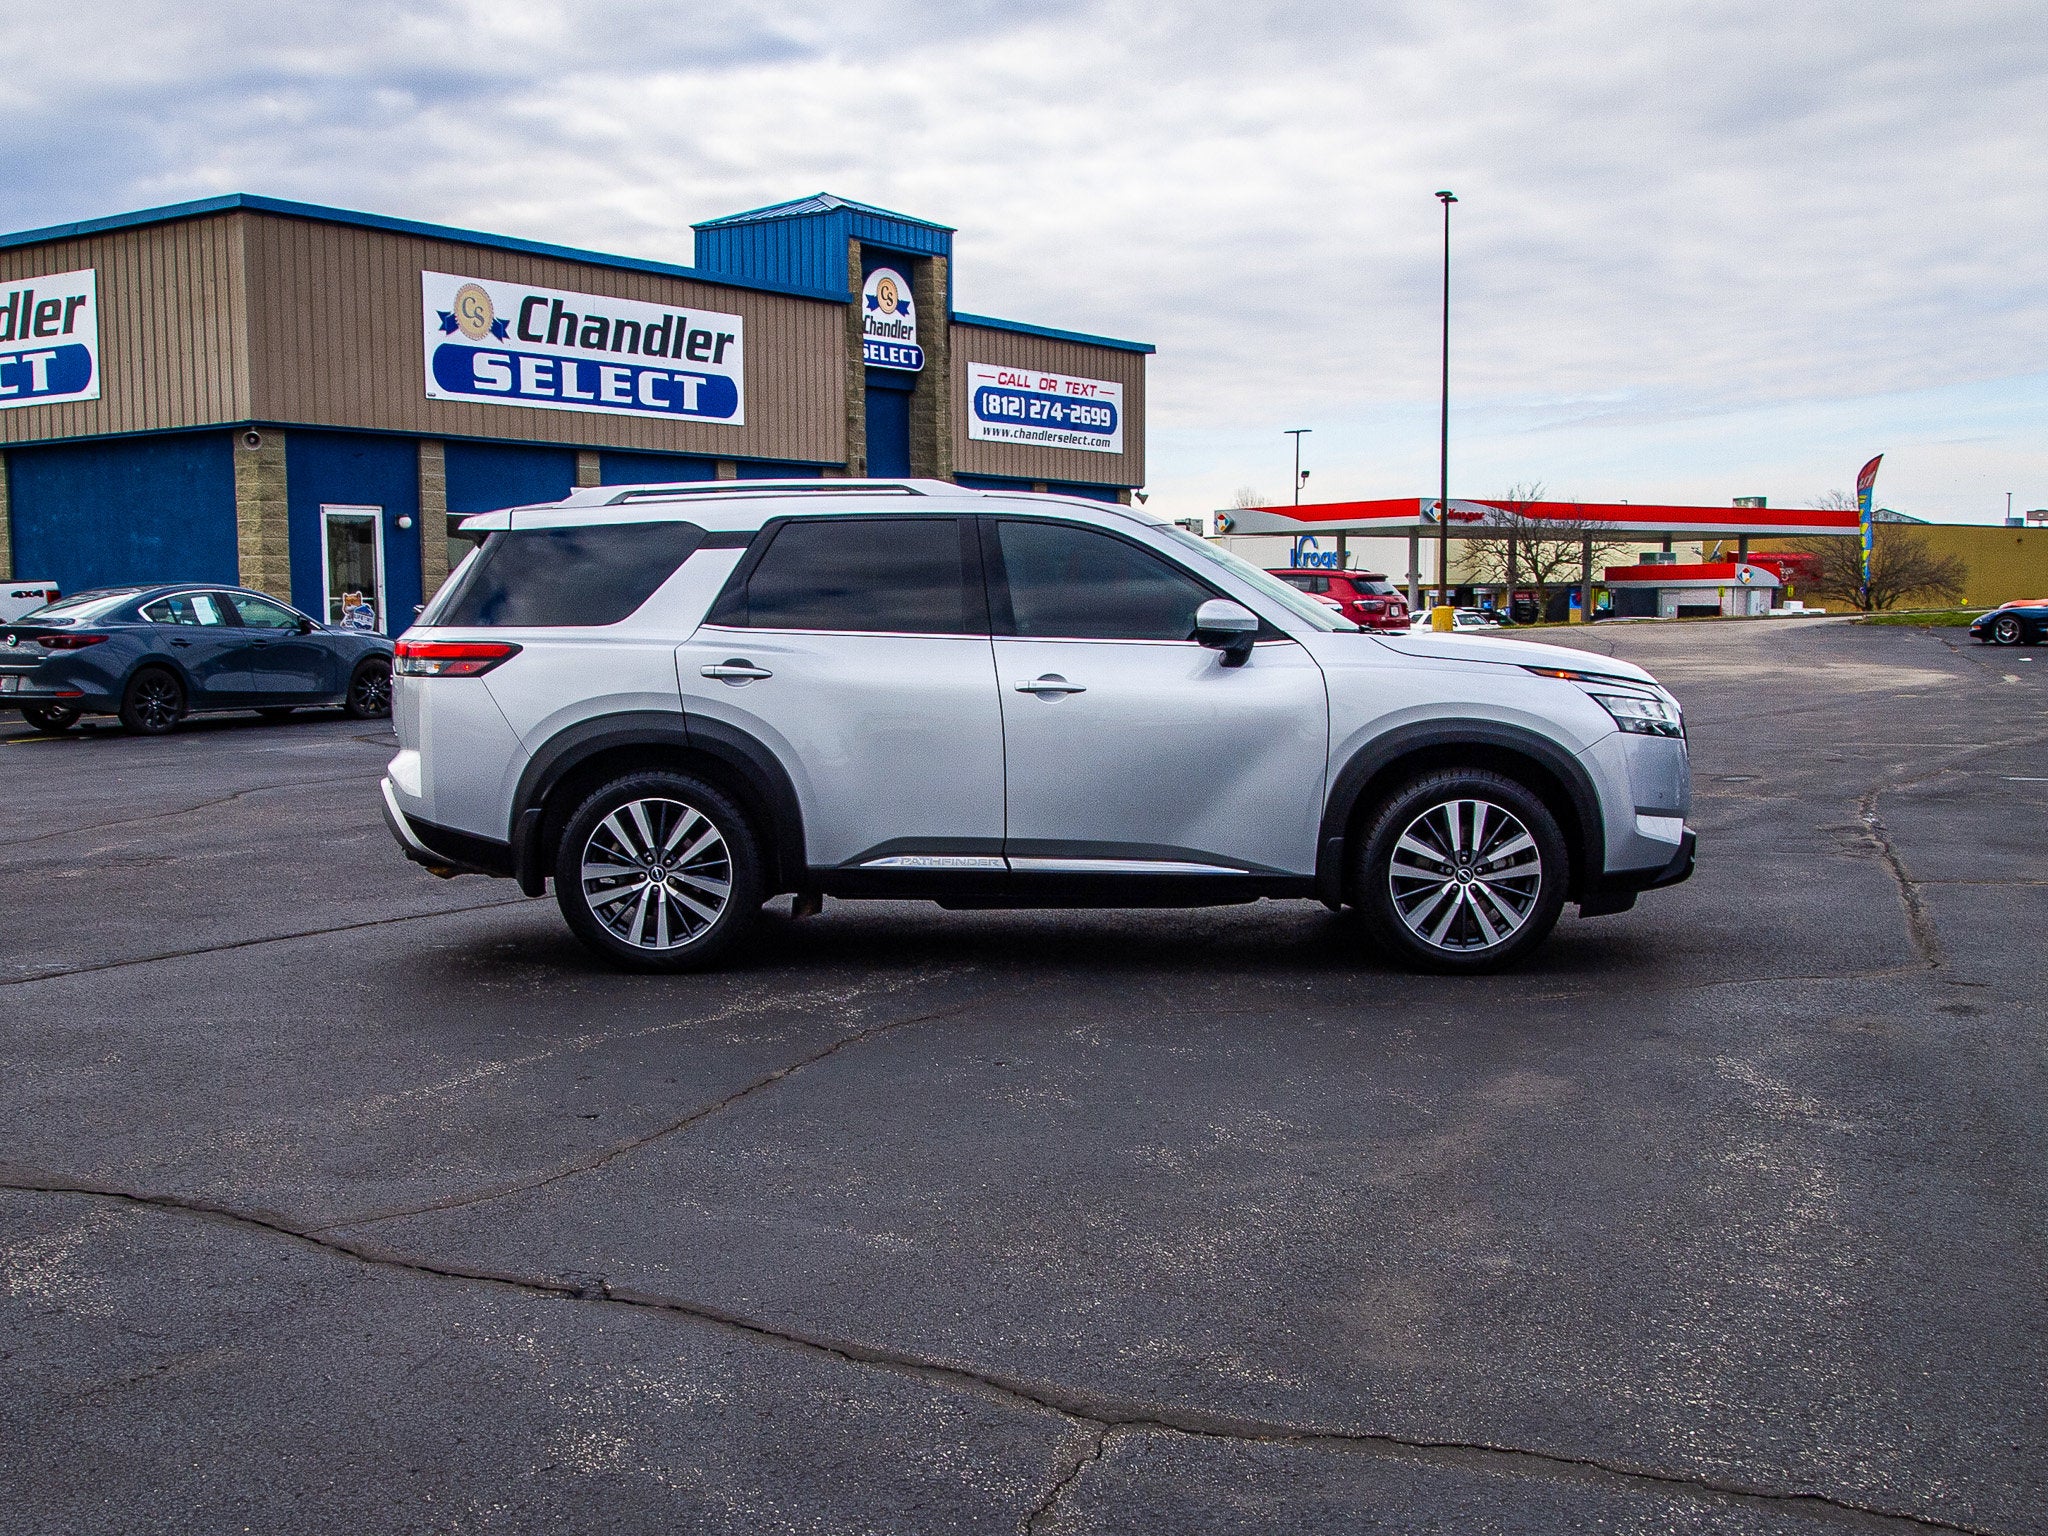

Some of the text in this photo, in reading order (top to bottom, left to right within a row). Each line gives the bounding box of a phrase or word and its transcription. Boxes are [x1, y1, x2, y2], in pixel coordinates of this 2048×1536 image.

[516, 295, 735, 365] Chandler
[472, 352, 707, 410] SELECT
[997, 372, 1098, 397] CALL OR TEXT
[982, 392, 1111, 427] (812) 274-2699
[982, 426, 1111, 447] www.chandlerselect.com
[900, 858, 1001, 867] PATHFINDER
